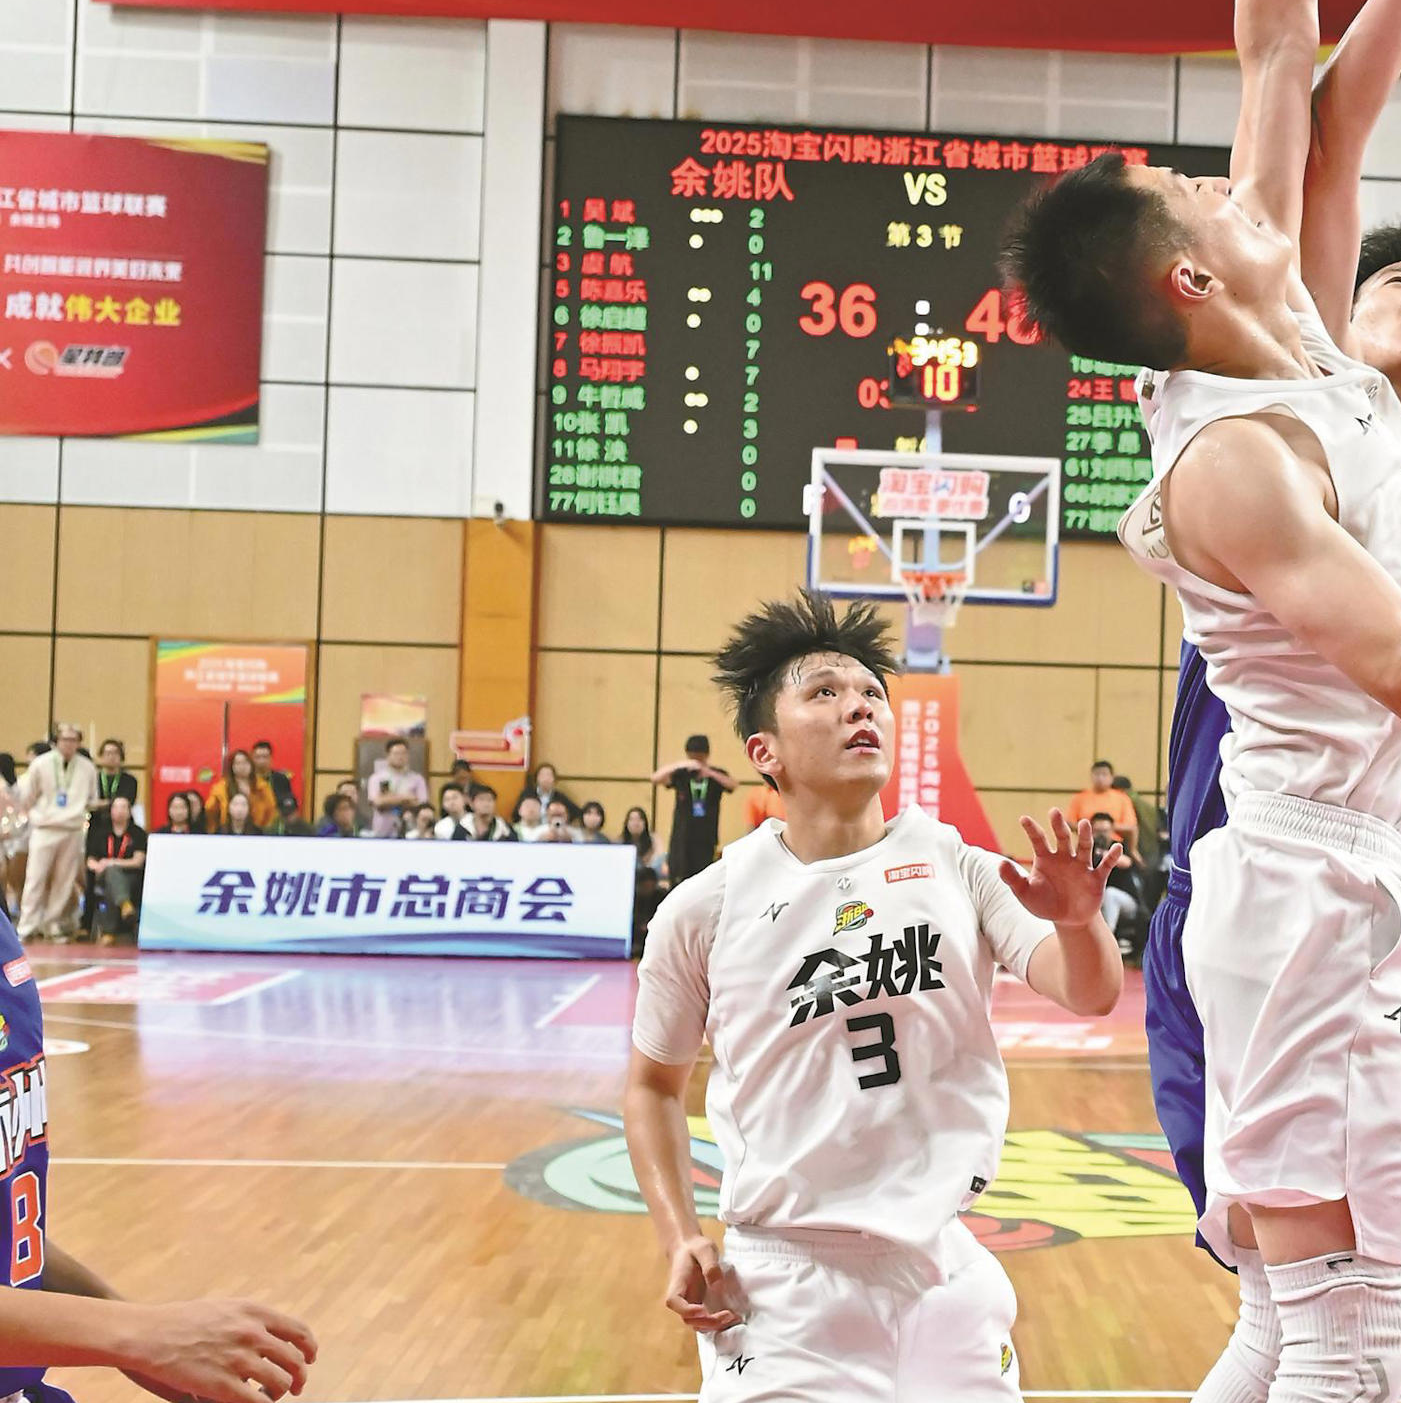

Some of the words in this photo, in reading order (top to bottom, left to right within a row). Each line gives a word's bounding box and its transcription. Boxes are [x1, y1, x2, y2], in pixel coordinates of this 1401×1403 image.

[671, 157, 795, 202] 余姚队
[903, 171, 948, 206] VS
[749, 208, 765, 228] 2
[748, 234, 764, 255] 0
[750, 261, 773, 281] 11
[746, 287, 762, 307] 4
[5, 291, 182, 326] 成就伟大企业
[799, 281, 878, 337] 36
[746, 313, 762, 334] 0
[746, 339, 761, 360] 7
[745, 366, 760, 386] 7
[925, 364, 960, 401] 10
[743, 392, 759, 413] 2
[743, 419, 758, 439] 3
[742, 445, 758, 465] 0
[741, 471, 757, 492] 0
[740, 498, 757, 518] 0
[197, 868, 575, 923] 余姚市总商会
[790, 923, 946, 1027] 余姚
[846, 1011, 901, 1090] 3
